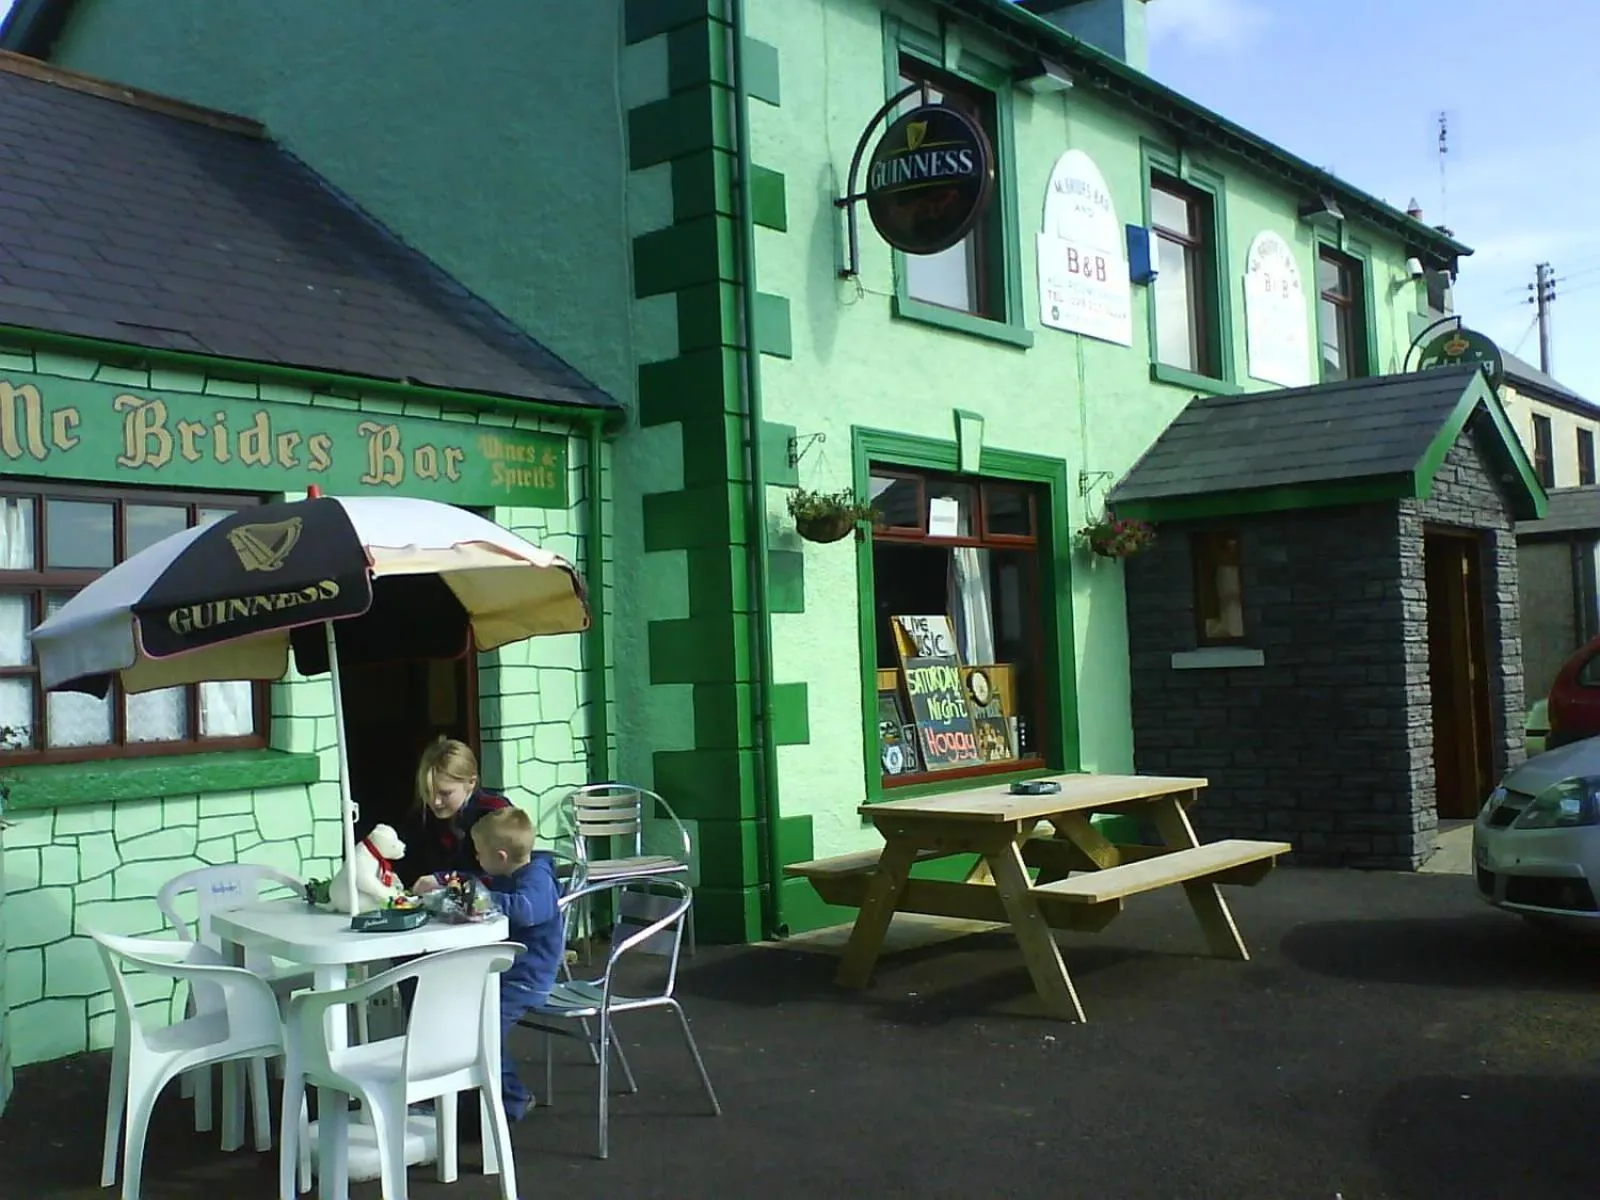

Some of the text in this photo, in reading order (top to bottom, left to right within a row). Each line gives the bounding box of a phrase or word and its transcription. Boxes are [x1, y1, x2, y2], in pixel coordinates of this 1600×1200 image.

[871, 149, 973, 190] GUINNESS
[113, 393, 333, 474] Brides
[358, 421, 465, 488] Bar
[478, 434, 557, 467] Wines &
[490, 461, 556, 494] Spirits
[168, 579, 341, 636] GUINNESS
[906, 665, 962, 697] SATURDAY
[926, 694, 968, 726] Night
